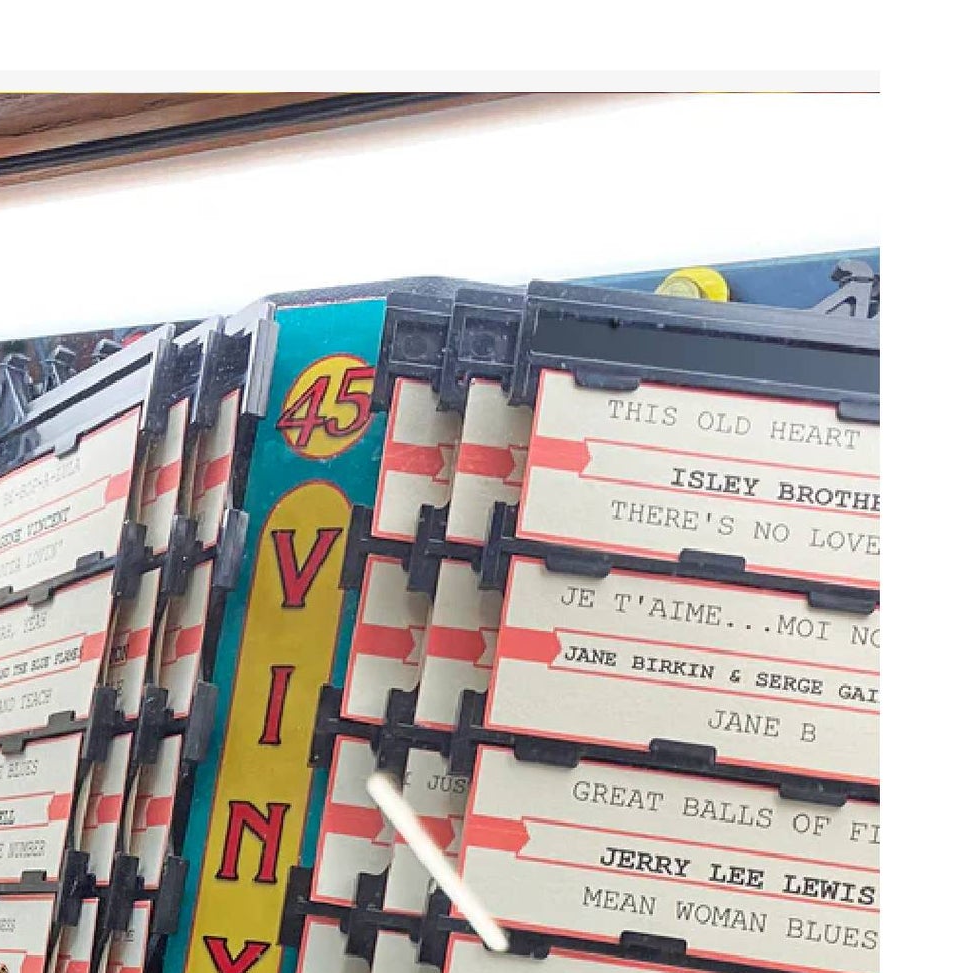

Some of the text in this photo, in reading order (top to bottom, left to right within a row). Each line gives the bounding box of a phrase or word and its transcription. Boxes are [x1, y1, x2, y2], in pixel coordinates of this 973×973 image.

[276, 366, 377, 448] 45
[608, 398, 861, 450] THIS OLD HEART
[670, 467, 761, 497] ISLEY
[611, 500, 880, 557] THERE'S NO LOVE
[561, 586, 596, 608] JE
[564, 645, 617, 668] JANE
[631, 655, 715, 681] BIRKIN
[729, 669, 741, 684] &
[755, 672, 824, 696] SERGE
[708, 710, 817, 743] JANE B
[571, 779, 665, 813] GREAT
[681, 796, 775, 830] BALLS
[792, 813, 831, 838] OF
[600, 846, 876, 906] JERRY LEE LEWIS
[581, 886, 879, 951] MEAN WOMAN BLUES
